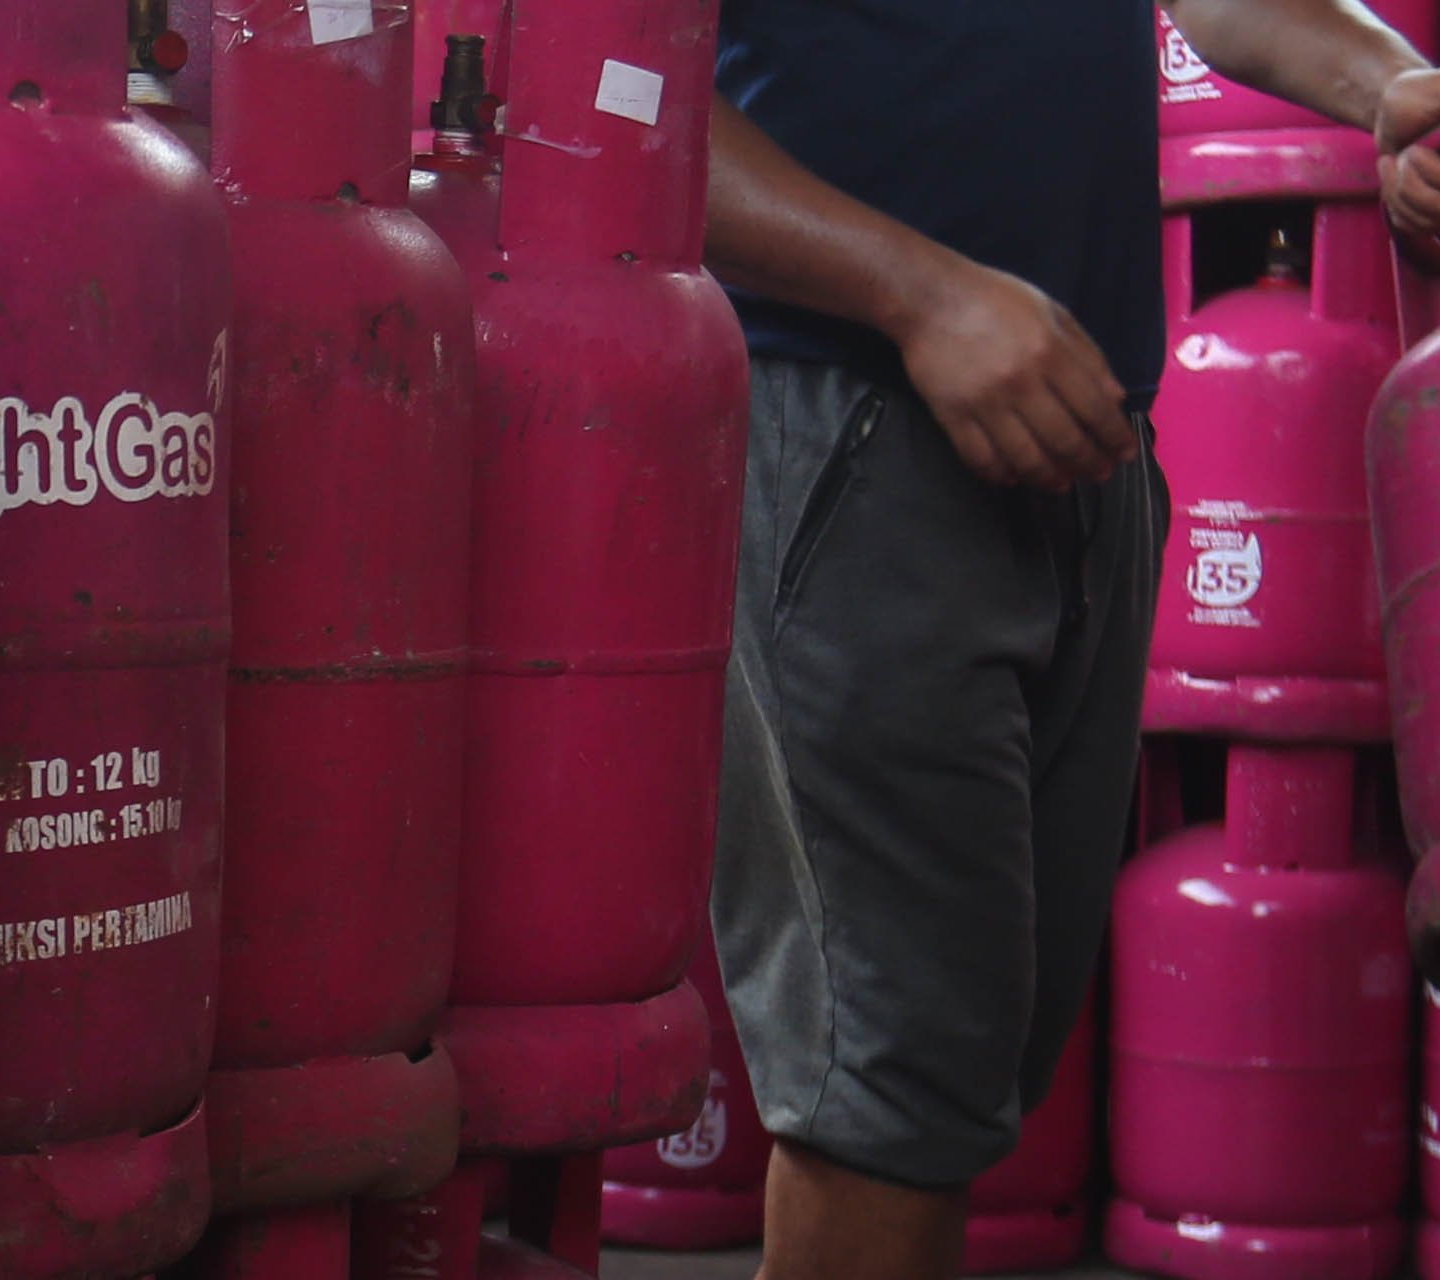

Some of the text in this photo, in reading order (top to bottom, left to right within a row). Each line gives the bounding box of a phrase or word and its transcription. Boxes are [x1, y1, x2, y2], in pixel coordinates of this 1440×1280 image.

[90, 750, 124, 793] 12
[131, 746, 161, 789] kg
[119, 799, 165, 841] 15.10
[72, 890, 193, 955] PERTAMINA
